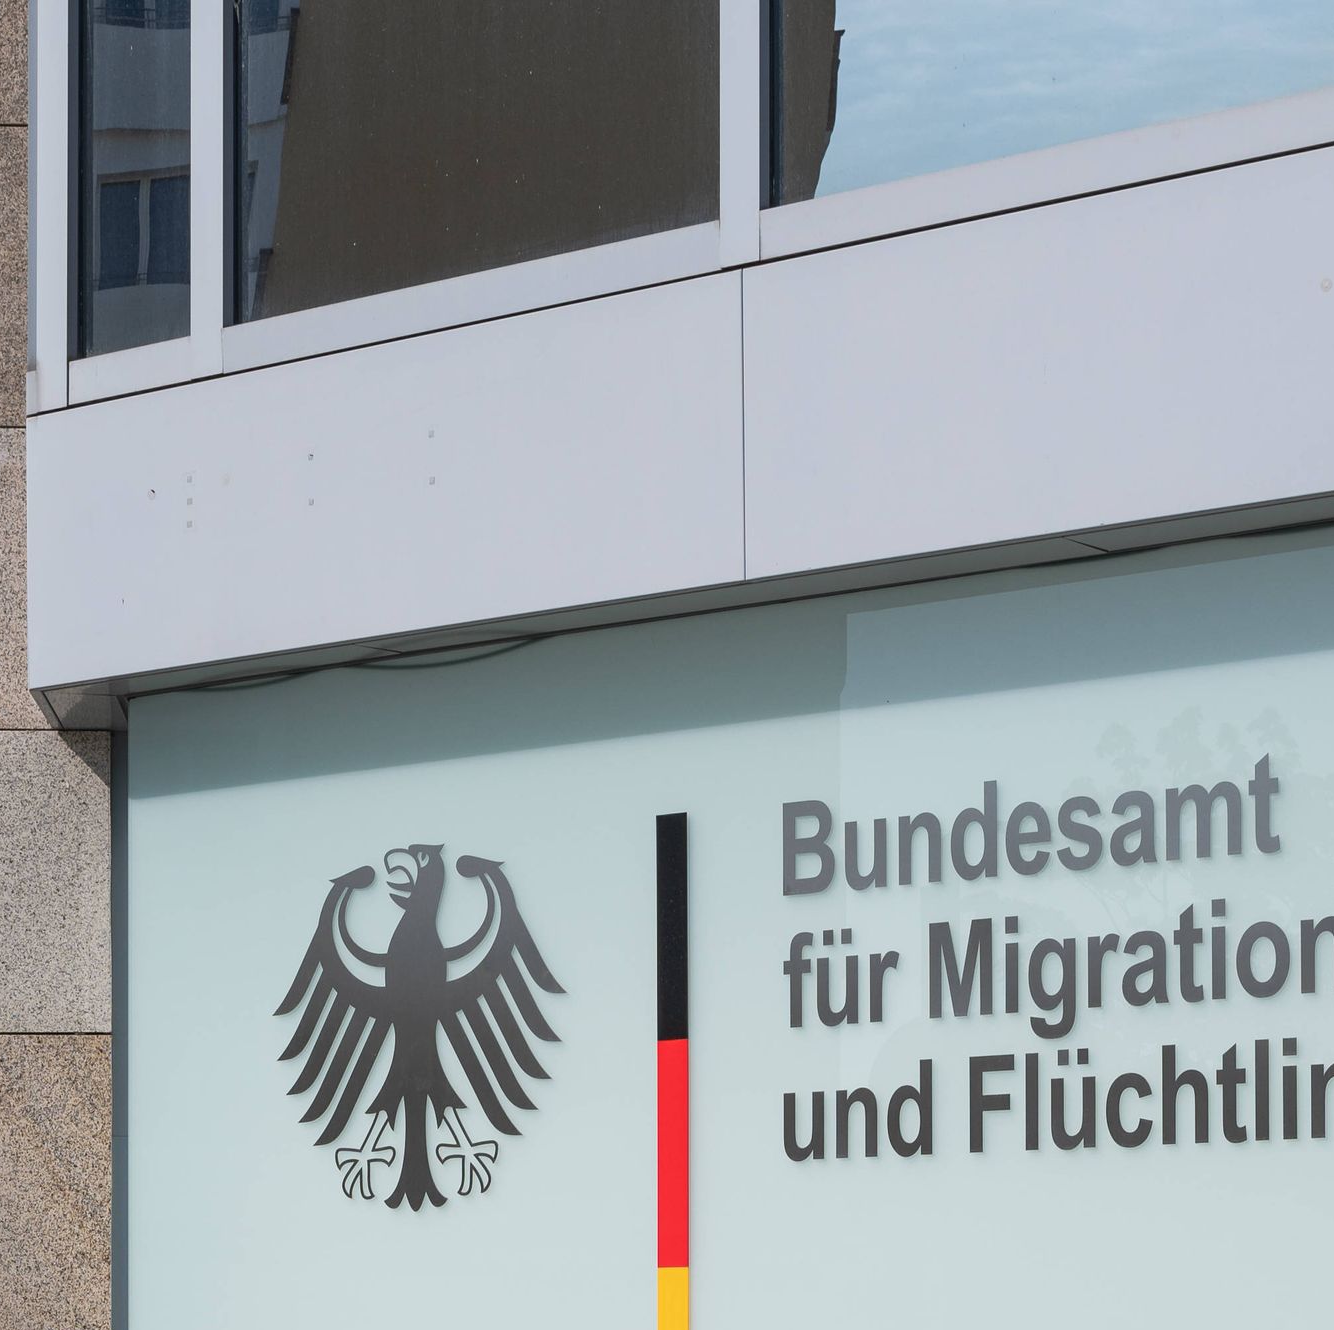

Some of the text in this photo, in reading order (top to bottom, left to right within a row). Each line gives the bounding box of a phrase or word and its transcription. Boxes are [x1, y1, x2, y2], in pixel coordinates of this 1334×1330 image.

[782, 752, 1282, 897] Bundesamt
[783, 927, 900, 1029] für
[783, 1058, 934, 1163] und
